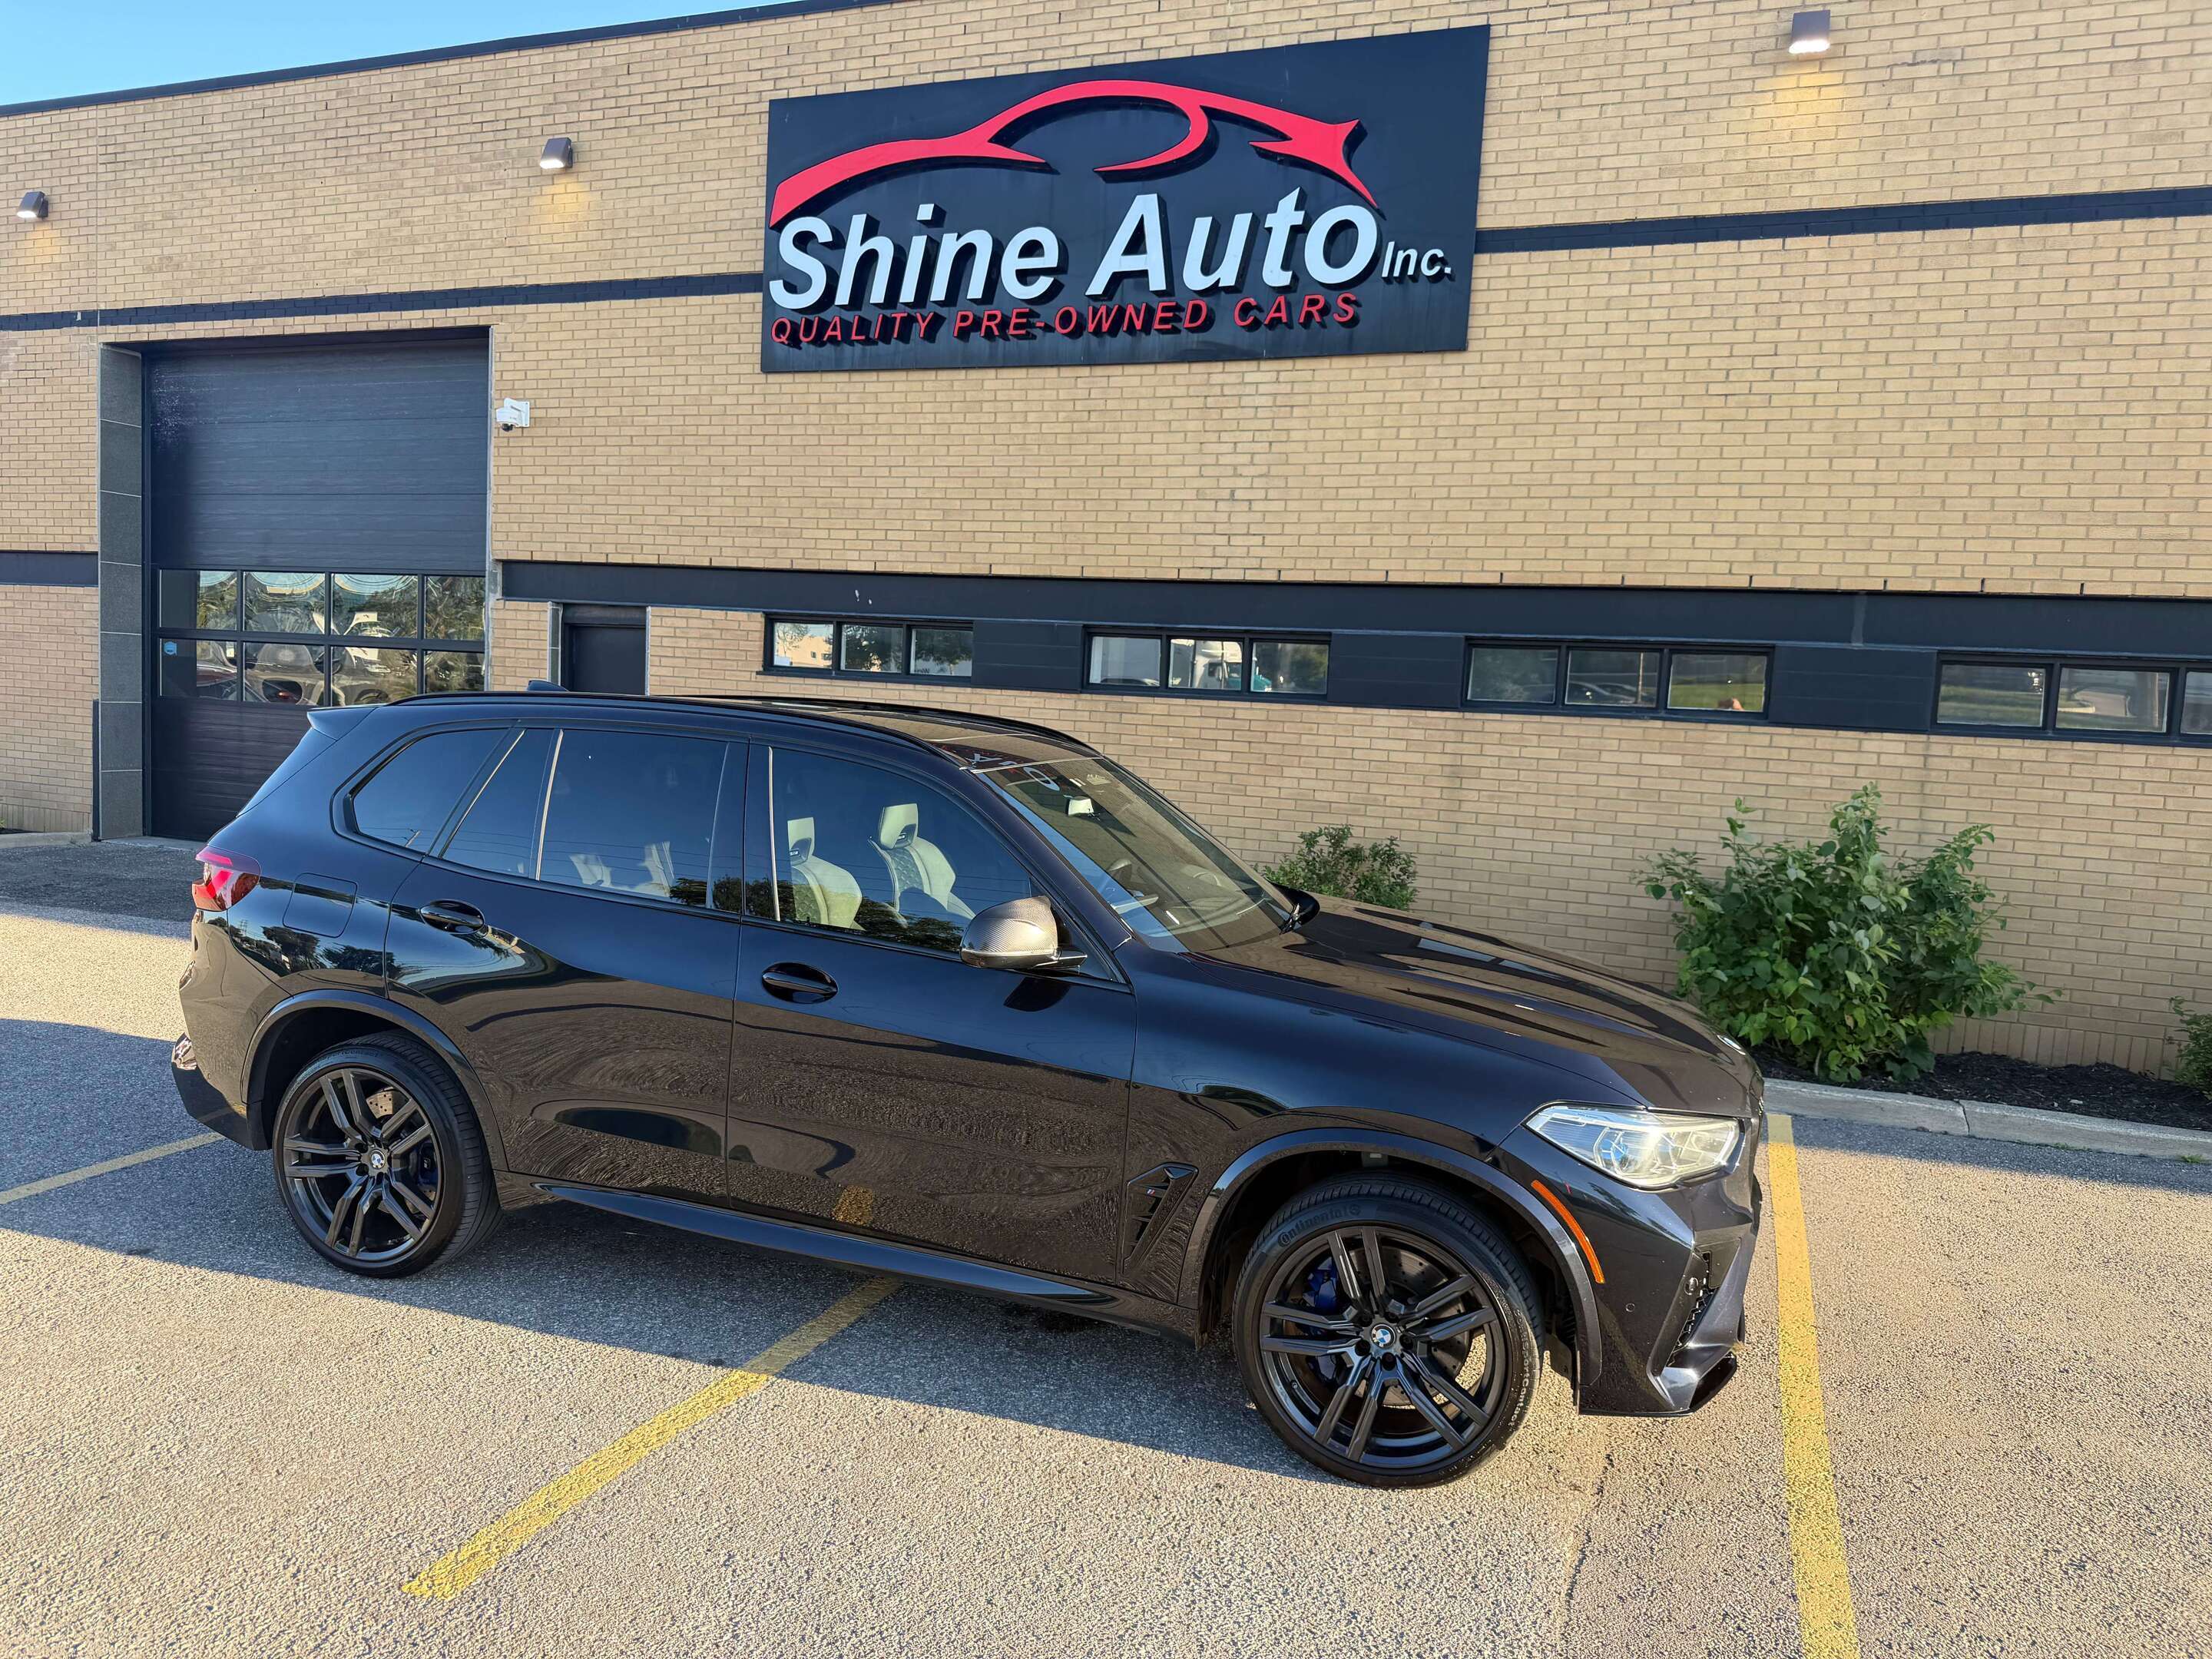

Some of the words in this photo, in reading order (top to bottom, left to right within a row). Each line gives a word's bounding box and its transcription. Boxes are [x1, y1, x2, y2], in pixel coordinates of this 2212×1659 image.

[769, 204, 1058, 310] Shine
[1085, 187, 1377, 296] Auto
[1382, 241, 1452, 277] Inc.
[770, 313, 935, 344] QUALITY
[953, 300, 1208, 336] PRE-OWNED
[1233, 293, 1358, 327] CARS
